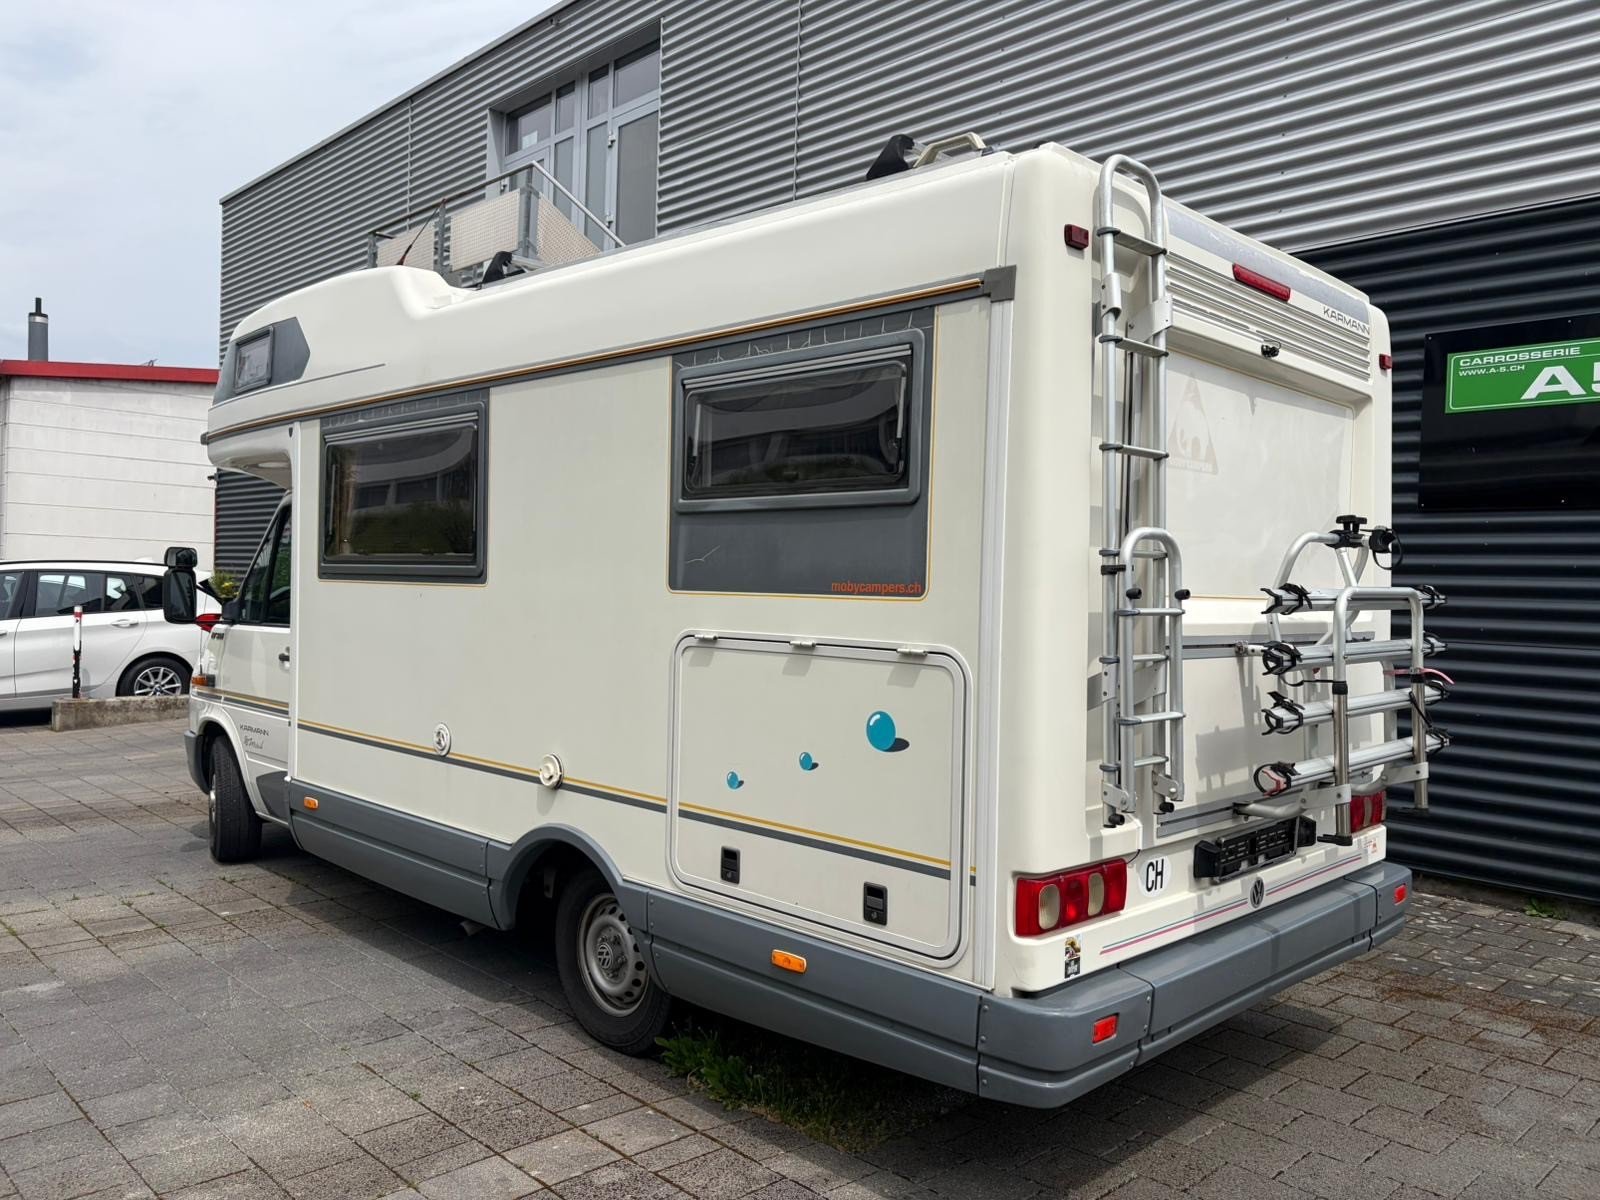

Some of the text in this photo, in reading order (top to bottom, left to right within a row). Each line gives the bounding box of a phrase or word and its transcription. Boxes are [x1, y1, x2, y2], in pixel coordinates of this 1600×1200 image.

[1323, 306, 1370, 336] KARMANN
[1460, 347, 1581, 367] CARROSSERIE
[1458, 365, 1526, 377] WWW.A-5.CH
[1520, 362, 1600, 400] A
[831, 581, 922, 595] mobycampers.ch
[1145, 858, 1165, 892] CH
